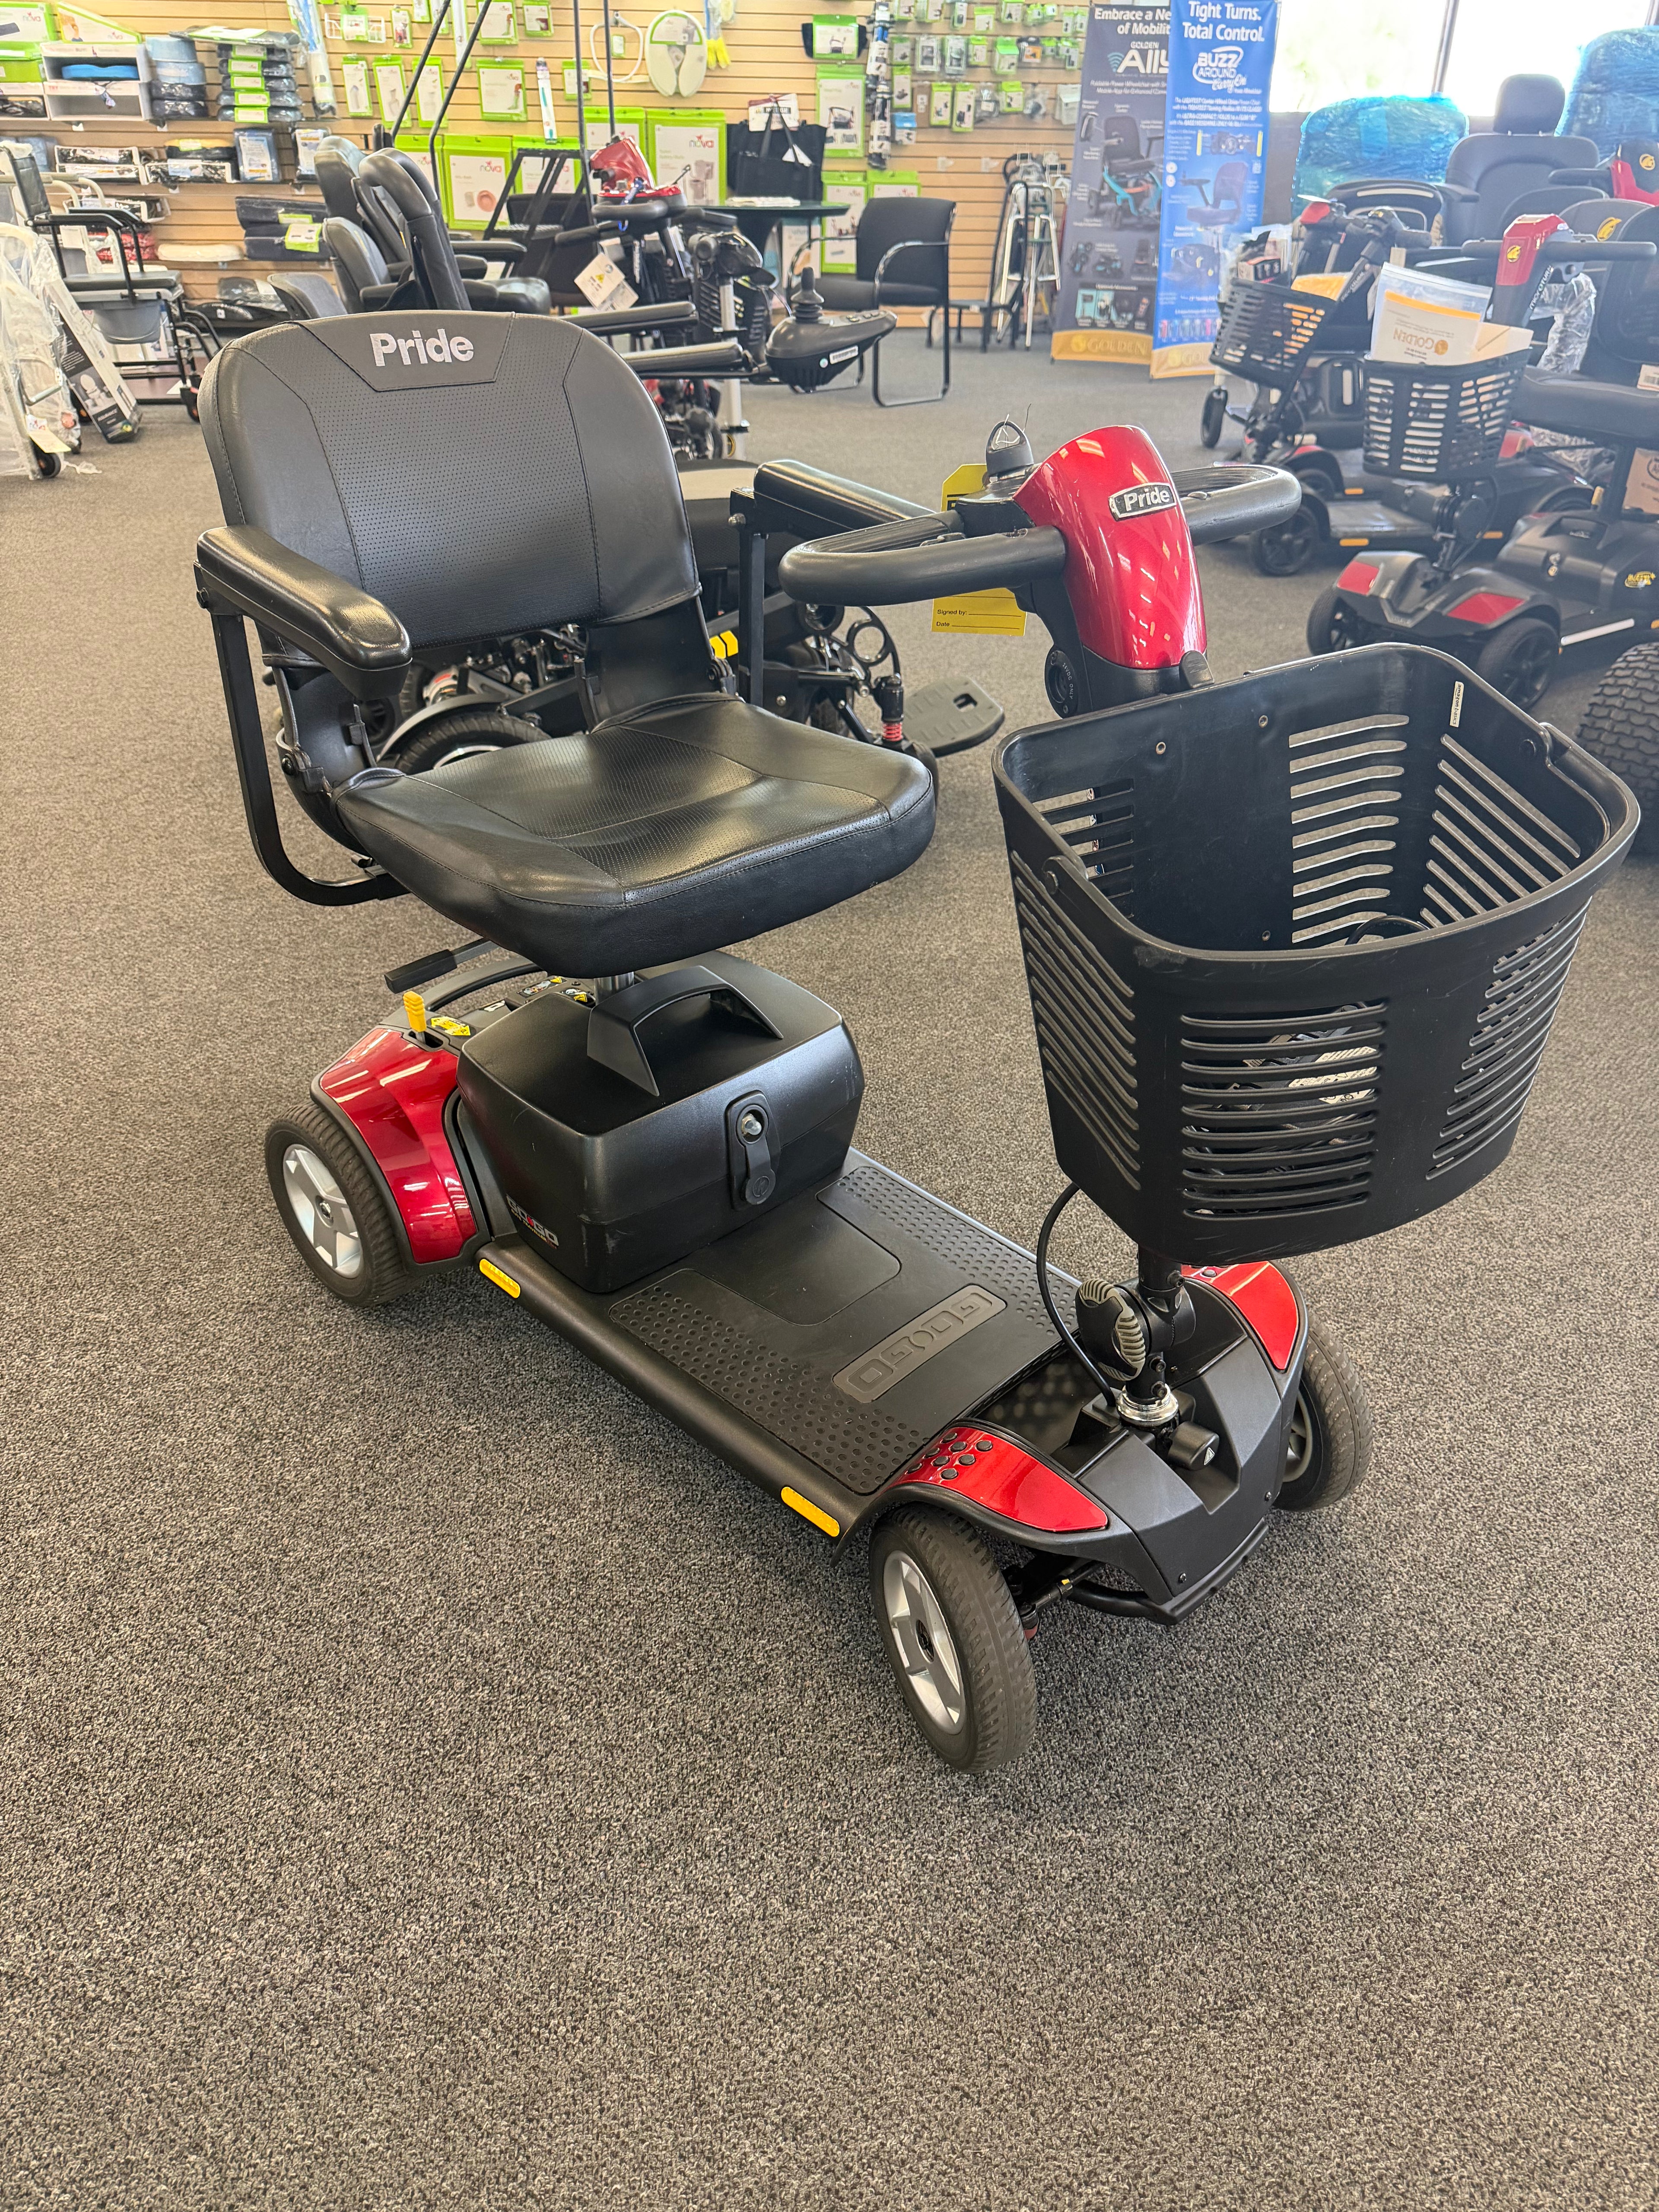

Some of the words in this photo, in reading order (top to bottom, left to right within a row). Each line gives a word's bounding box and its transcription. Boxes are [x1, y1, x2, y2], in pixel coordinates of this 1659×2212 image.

[1095, 8, 1143, 20] Embrace
[1145, 11, 1153, 20] a
[1155, 9, 1172, 20] Ne
[1188, 0, 1222, 22] Tight
[1224, 3, 1262, 20] Turns.
[1117, 23, 1131, 34] of
[1132, 23, 1170, 35] Mobilit
[1182, 22, 1213, 39] Total
[1216, 24, 1265, 41] Control.
[1198, 52, 1238, 67] BUZZ
[1198, 67, 1237, 78] AROUND
[689, 137, 714, 148] nova
[480, 162, 502, 173] nova
[370, 328, 474, 366] Pride
[1087, 337, 1147, 356] GOLDEN
[1393, 327, 1434, 350] GOLDEN
[1123, 487, 1170, 512] Pride
[1062, 662, 1072, 680] 24VDC
